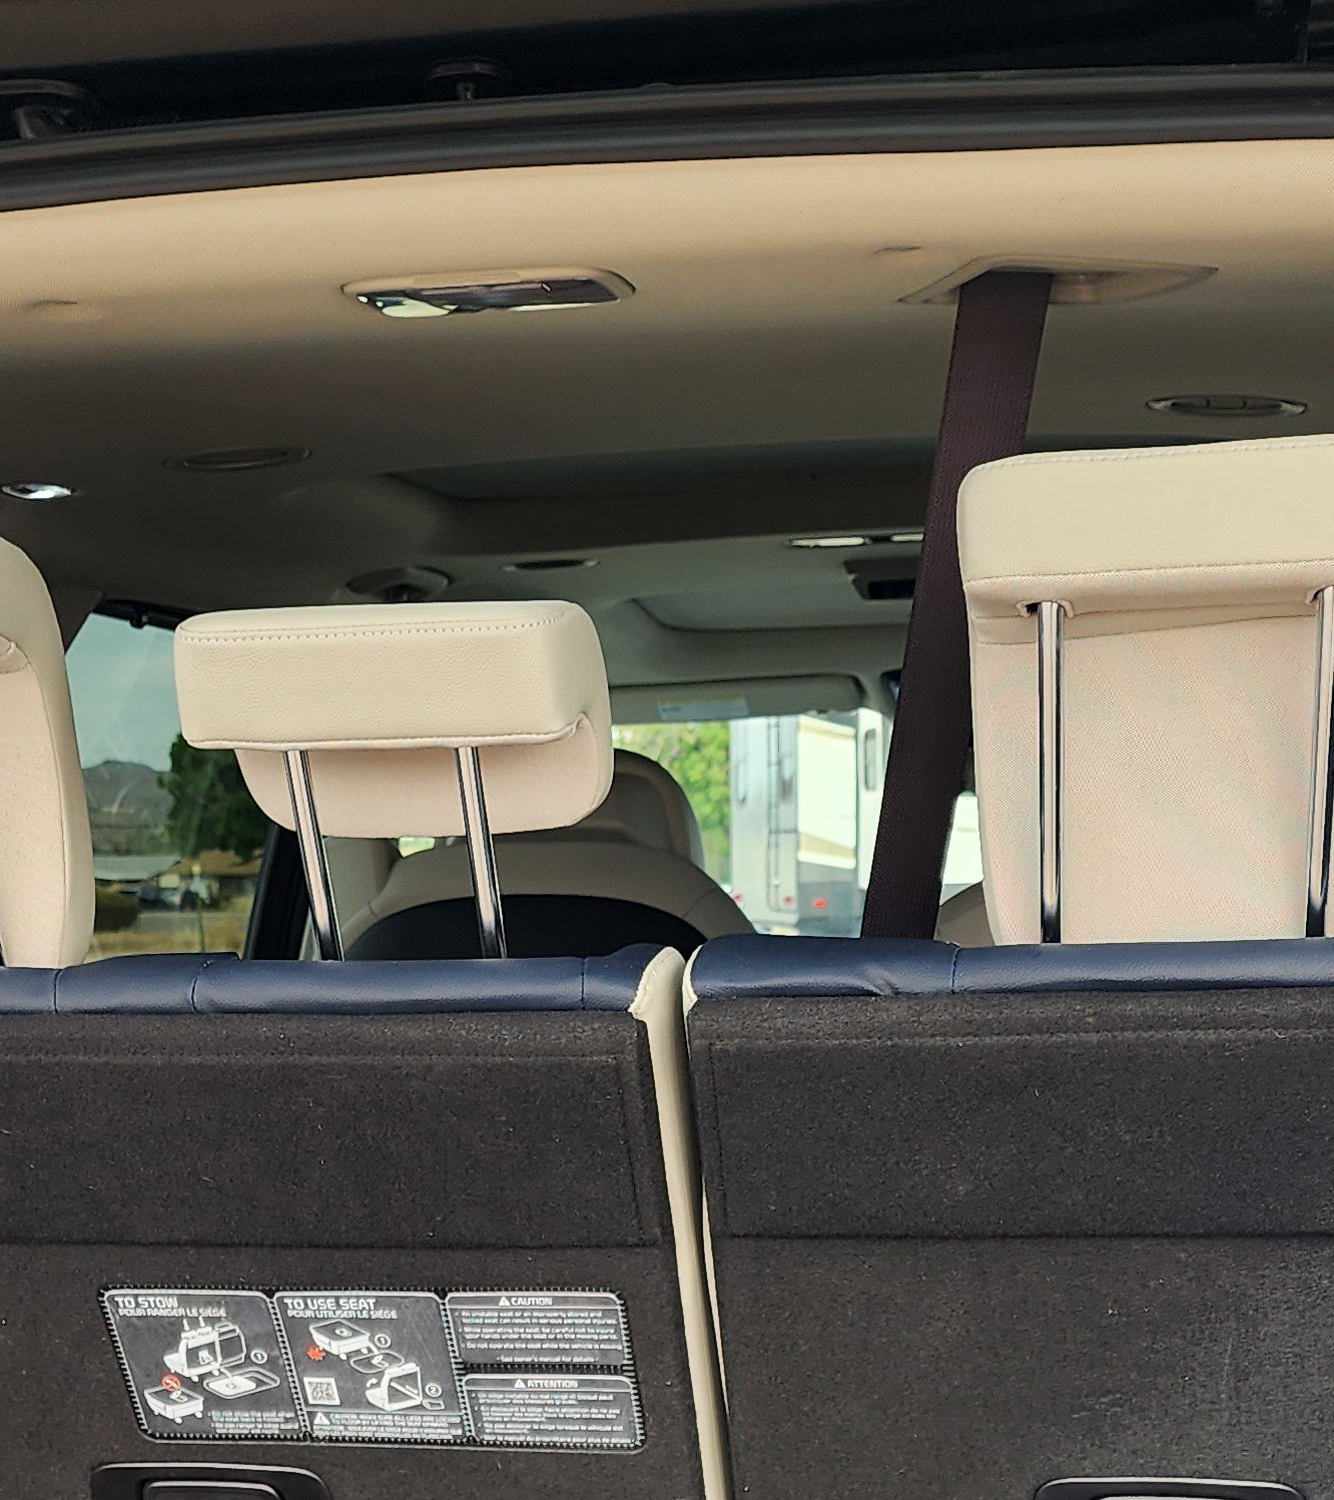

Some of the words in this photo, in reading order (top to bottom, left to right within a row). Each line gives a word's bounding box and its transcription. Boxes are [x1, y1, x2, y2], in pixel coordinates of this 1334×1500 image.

[114, 1297, 135, 1308] TO
[138, 1297, 179, 1308] STOW
[283, 1298, 304, 1310] TO
[307, 1298, 337, 1310] USE
[339, 1298, 376, 1310] SEAT
[510, 1297, 553, 1306] CAUTION
[118, 1308, 146, 1317] POUR
[287, 1310, 315, 1318] POUR
